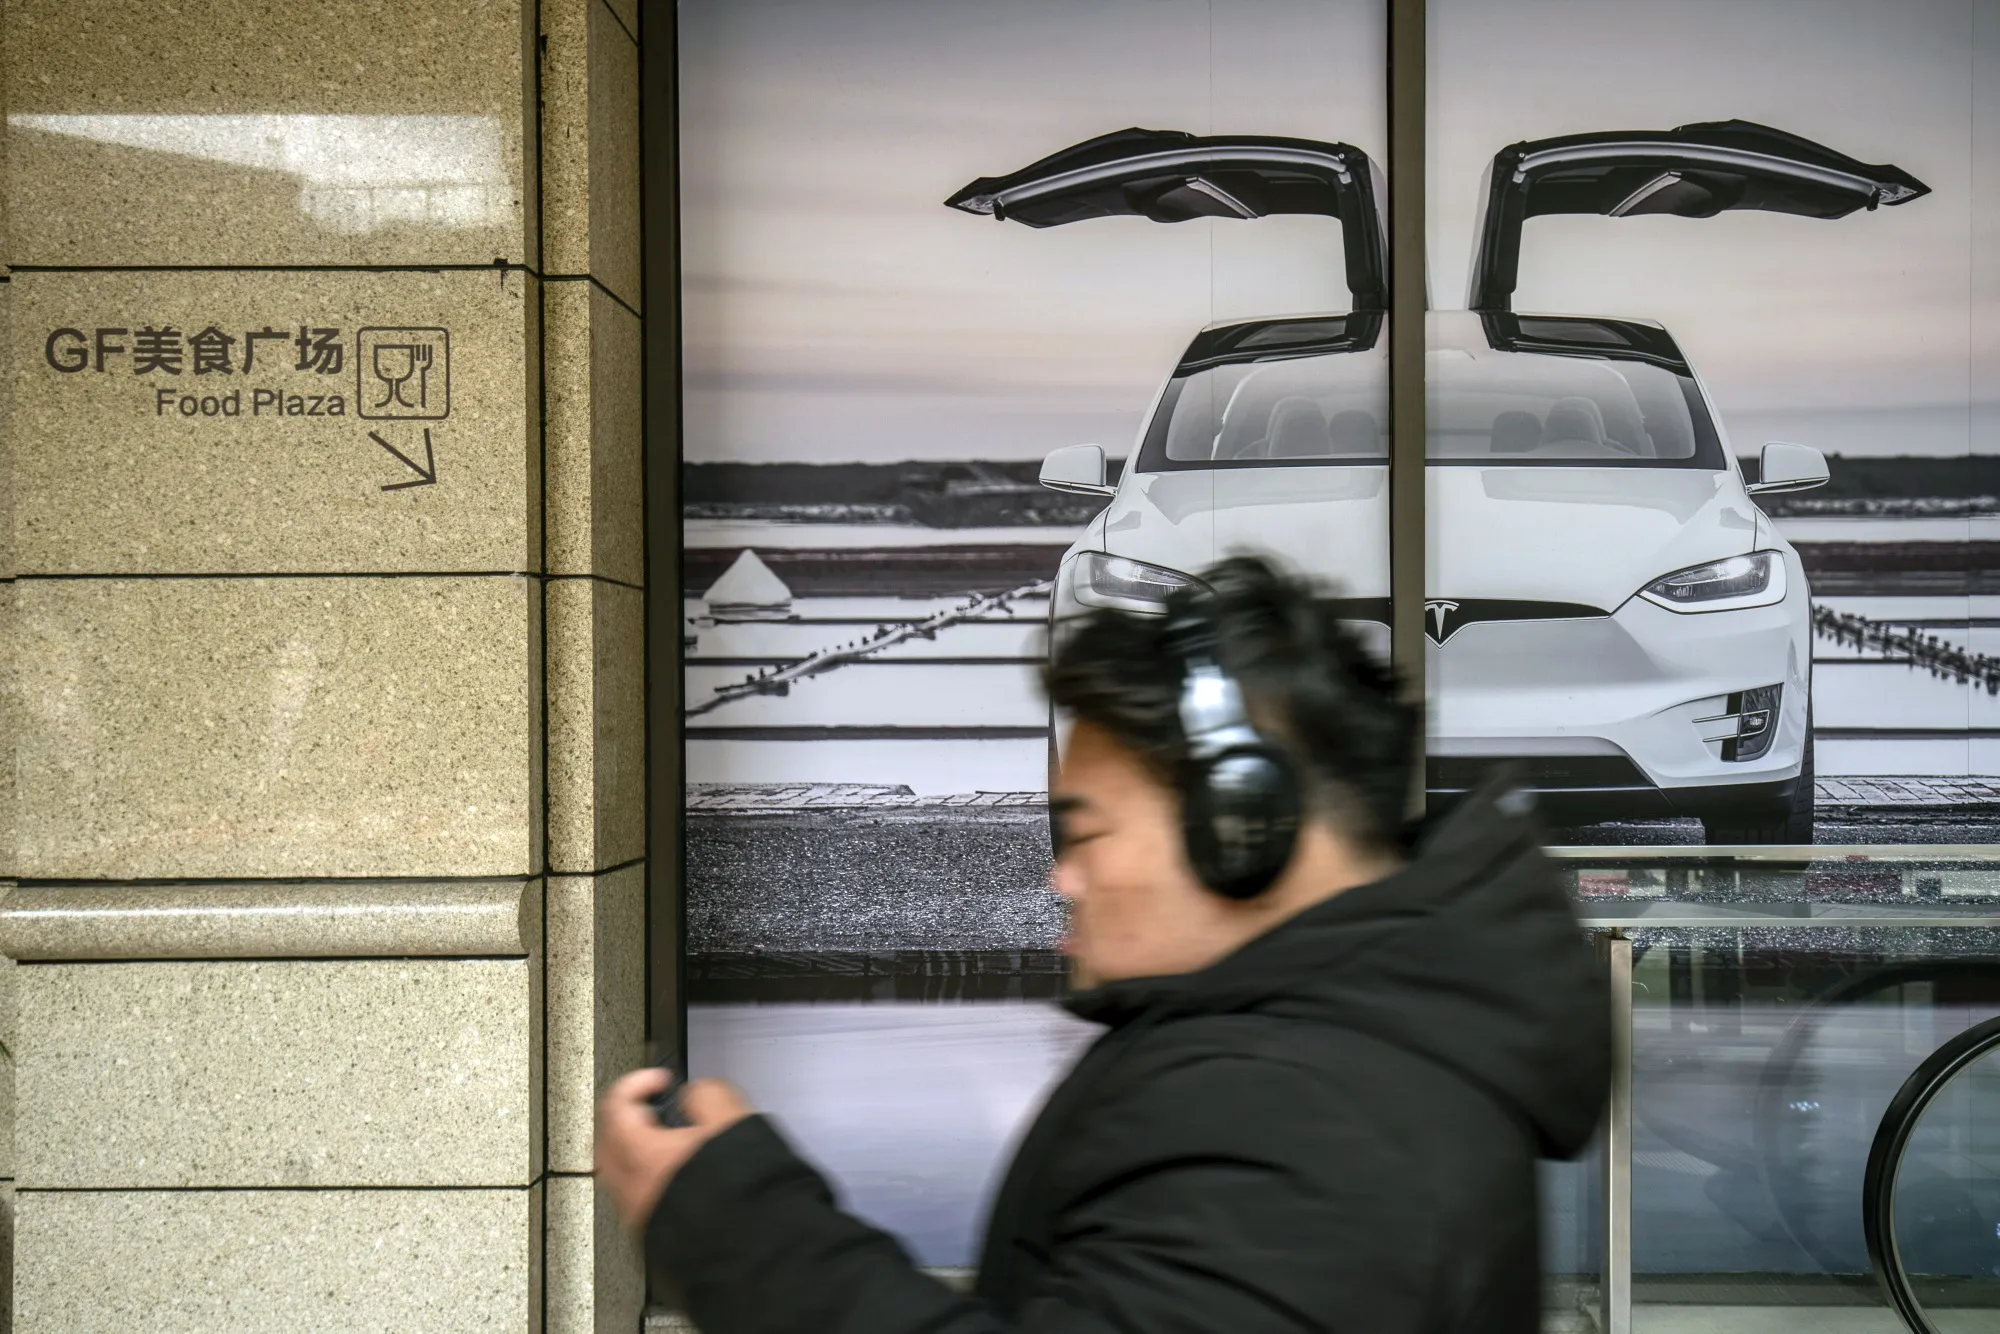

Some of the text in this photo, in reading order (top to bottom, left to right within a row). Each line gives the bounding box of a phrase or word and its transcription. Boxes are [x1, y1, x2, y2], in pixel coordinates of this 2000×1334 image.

[45, 325, 344, 375] GF美食广场
[157, 388, 346, 417] Food Plaza
